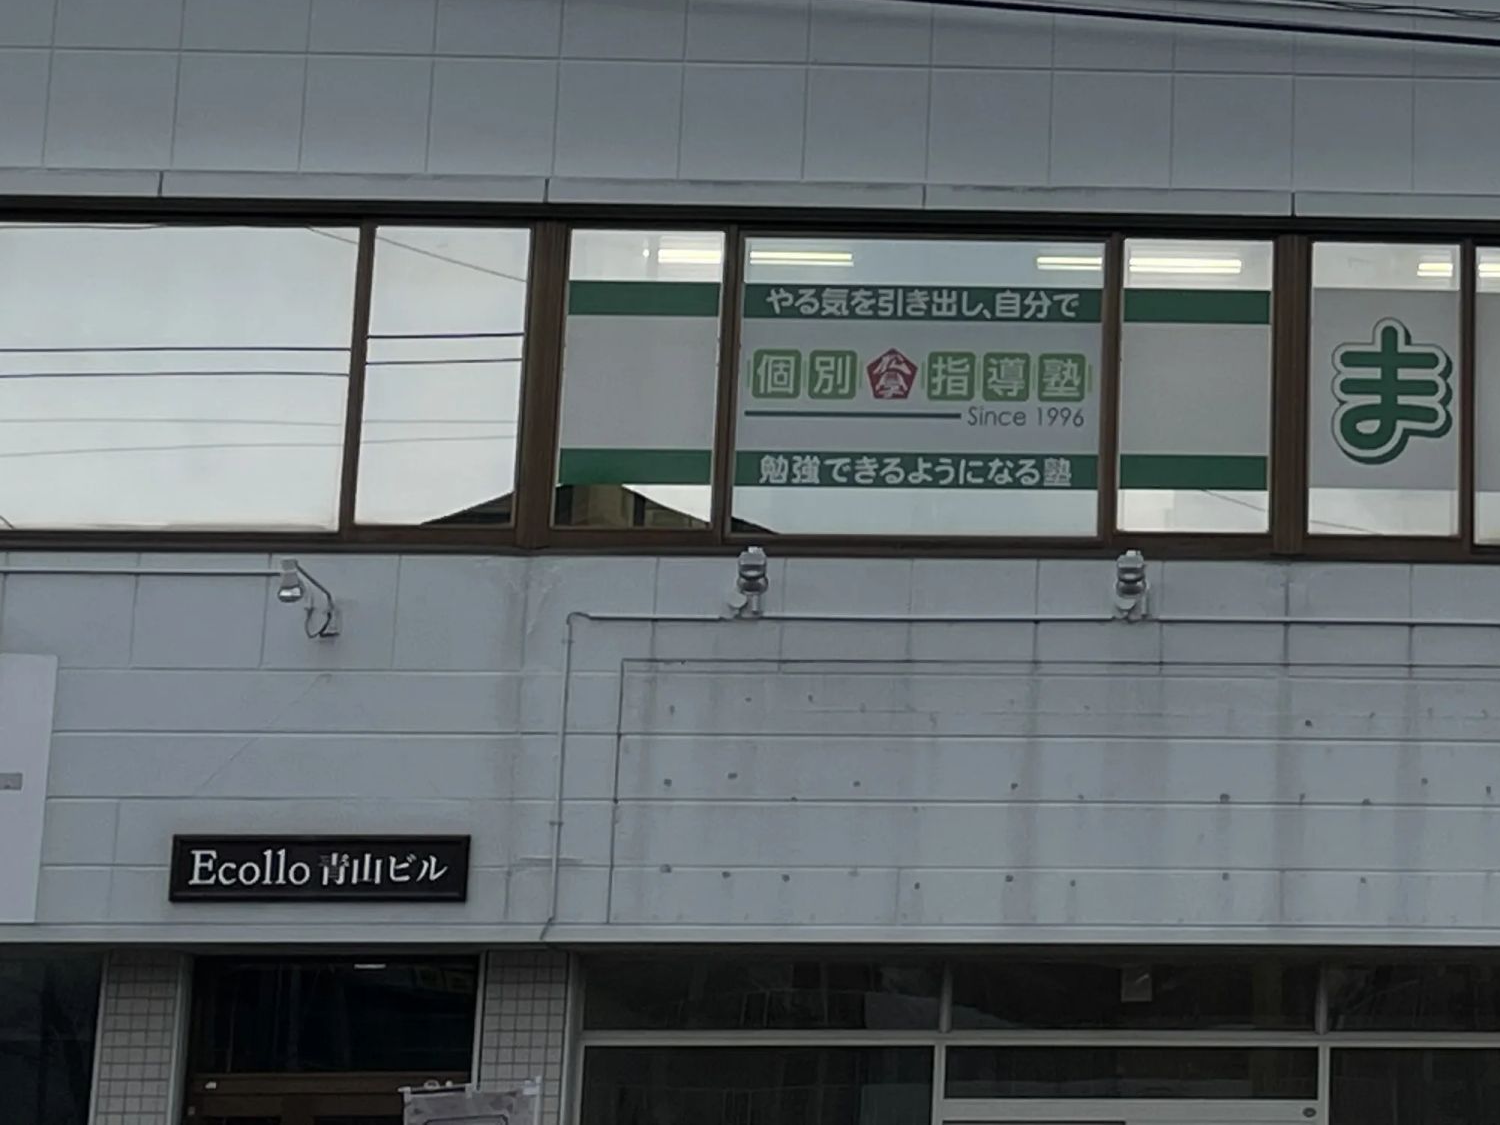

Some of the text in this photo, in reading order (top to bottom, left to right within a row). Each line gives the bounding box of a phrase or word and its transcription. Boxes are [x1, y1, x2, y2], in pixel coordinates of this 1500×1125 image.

[968, 406, 1084, 427] Since 1996
[759, 454, 1072, 487] 勉強できるようになる塾
[188, 848, 310, 886] Ecollo
